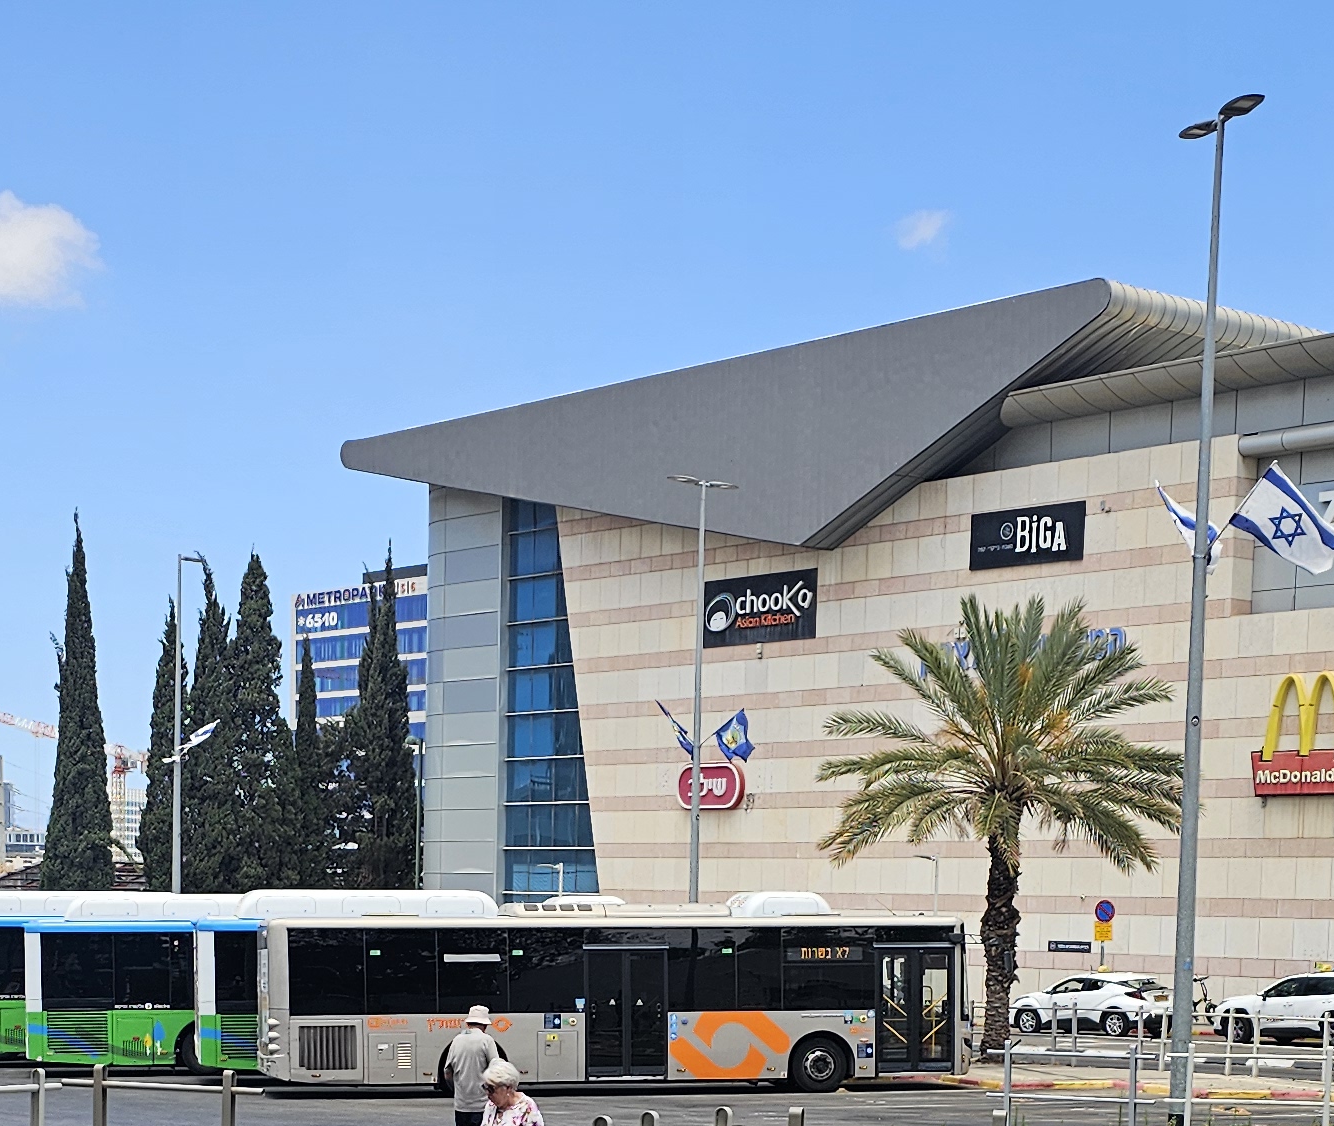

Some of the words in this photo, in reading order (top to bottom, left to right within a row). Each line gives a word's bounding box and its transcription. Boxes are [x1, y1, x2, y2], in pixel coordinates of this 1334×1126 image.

[735, 617, 760, 629] Asian
[760, 613, 796, 626] Kitchen
[800, 947, 832, 960] בשרות
[835, 946, 850, 959] לא
